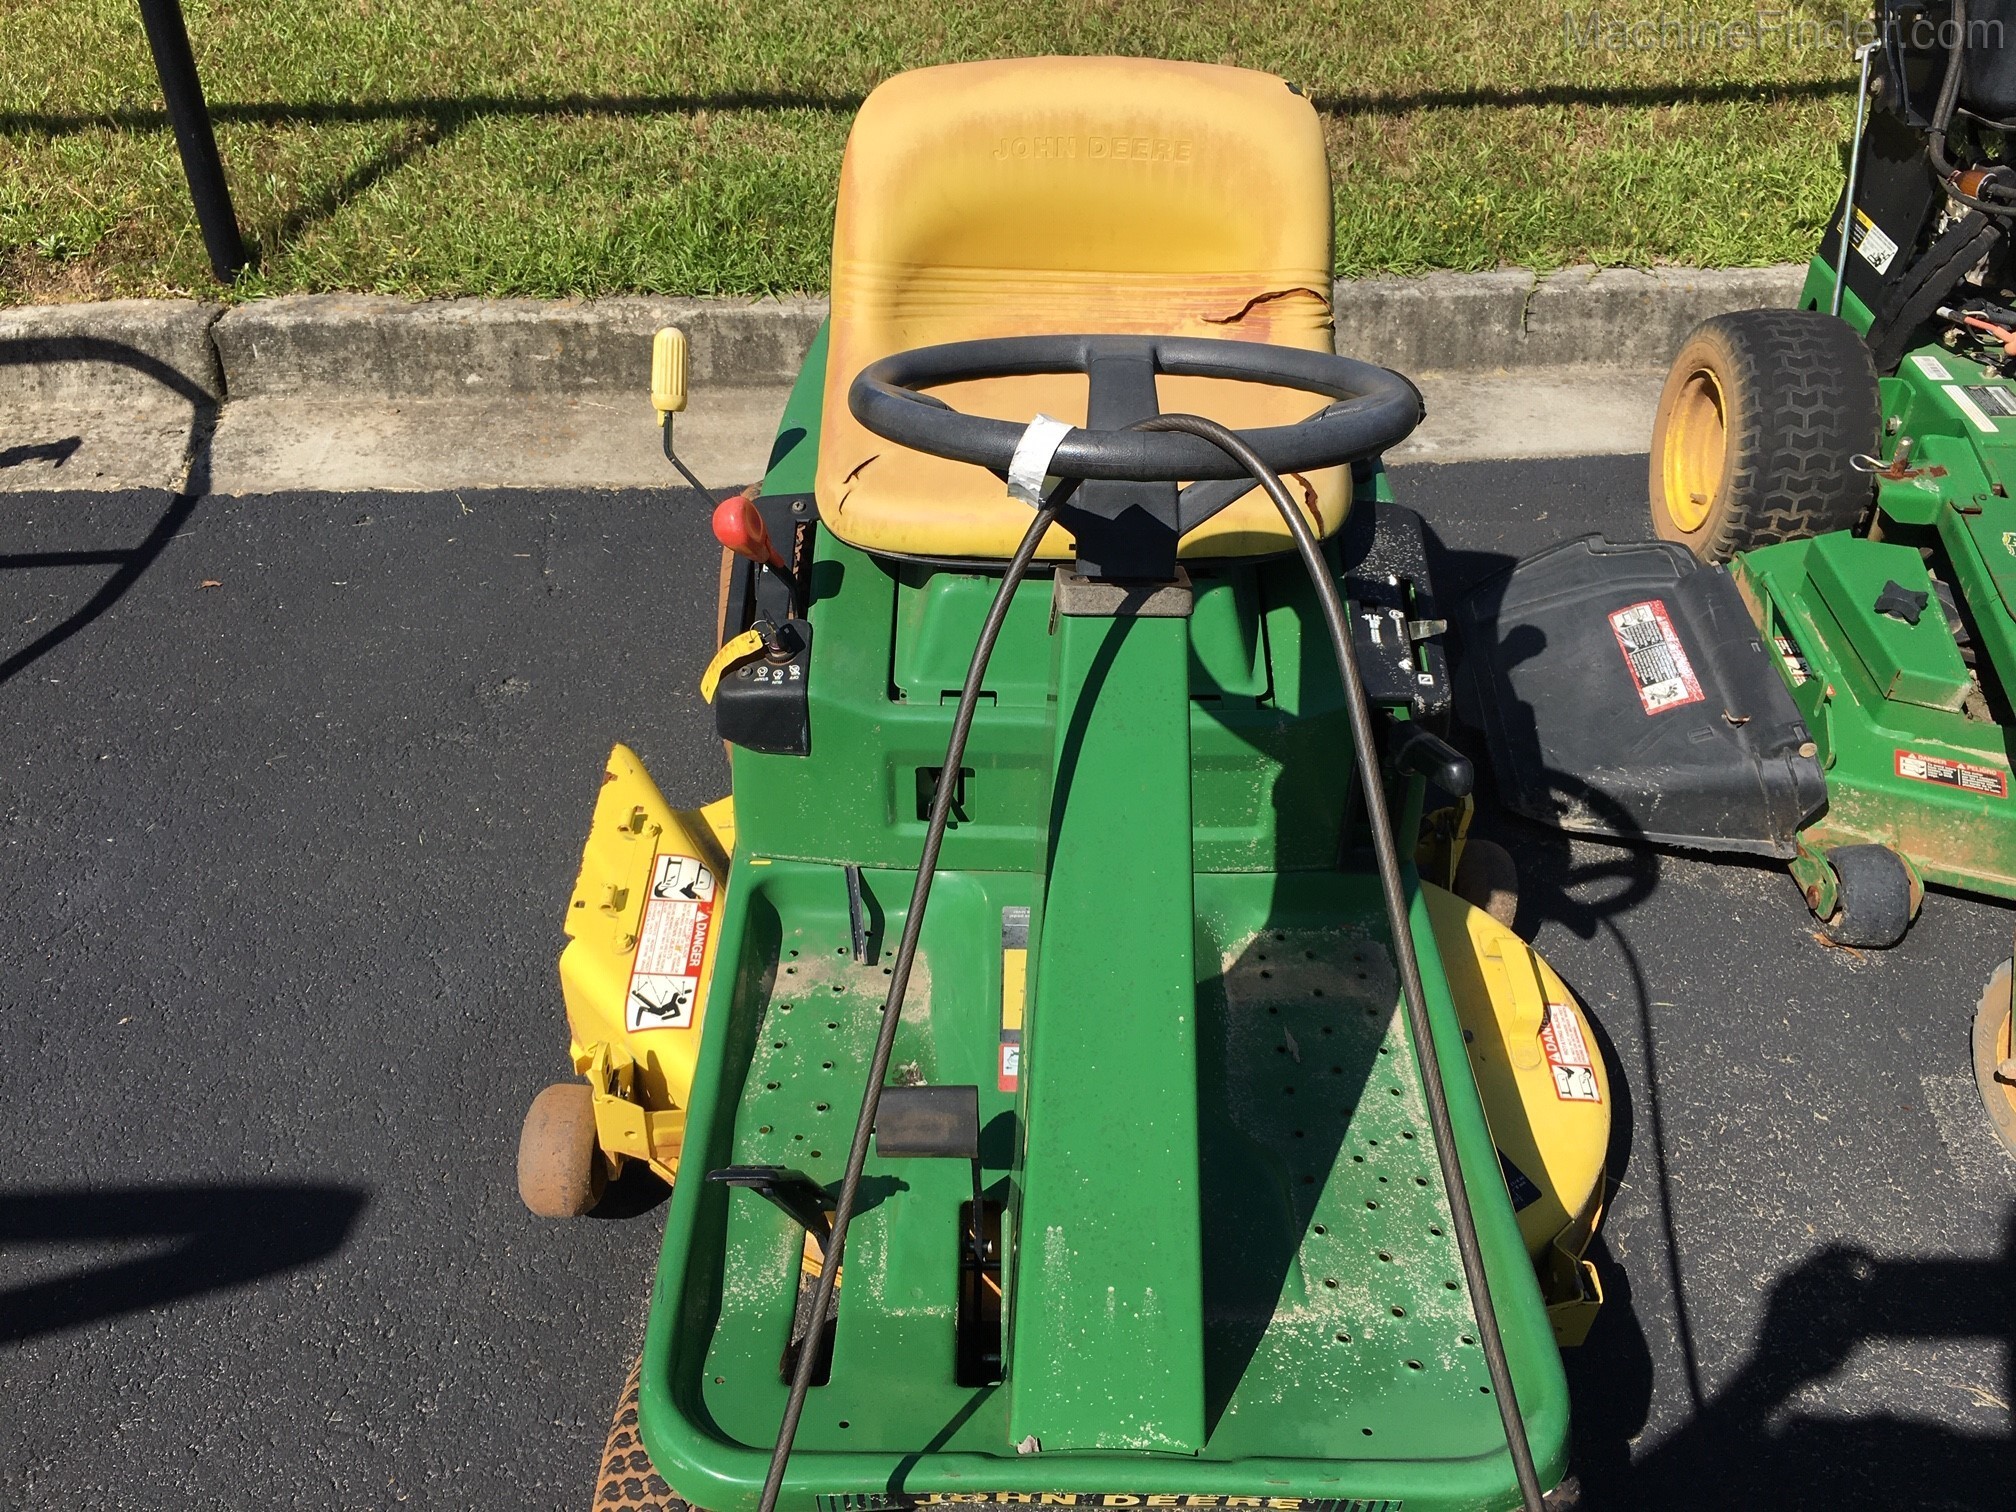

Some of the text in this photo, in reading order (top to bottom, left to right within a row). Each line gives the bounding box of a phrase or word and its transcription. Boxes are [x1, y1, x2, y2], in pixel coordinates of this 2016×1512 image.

[992, 136, 1193, 163] JOHN DEERE
[688, 922, 708, 967] DANGER
[914, 1492, 1303, 1510] JOHN DEERE
